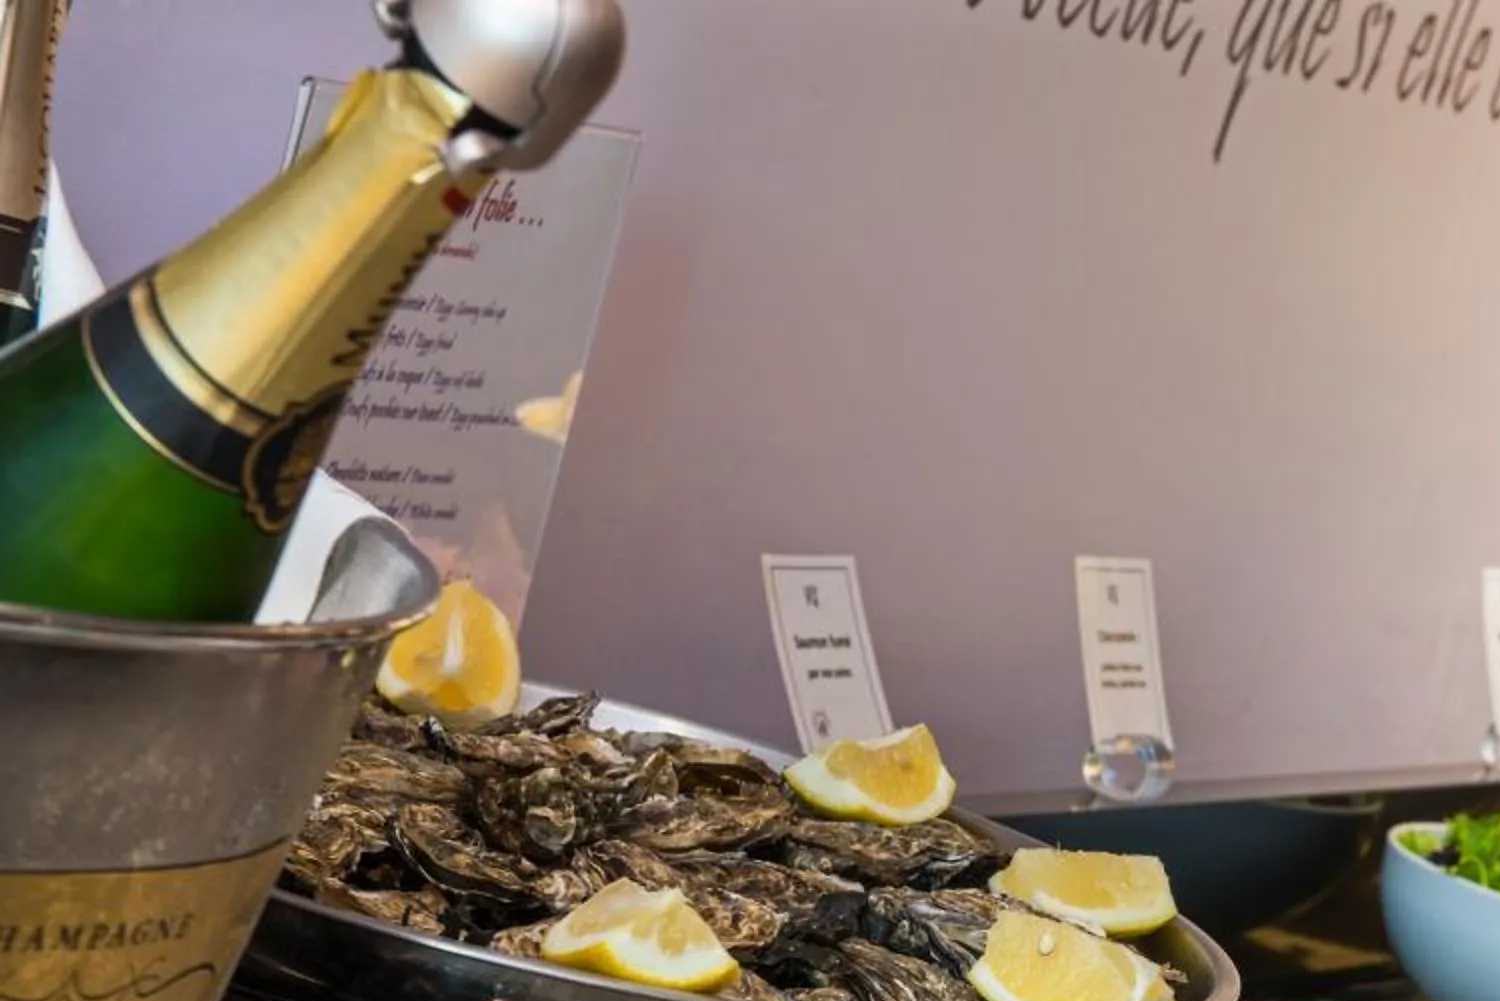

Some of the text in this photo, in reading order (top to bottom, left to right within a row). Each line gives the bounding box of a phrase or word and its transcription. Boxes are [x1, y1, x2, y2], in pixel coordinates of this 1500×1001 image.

[1213, 0, 1344, 164] que
[1334, 2, 1396, 93] si
[1396, 0, 1494, 113] elle
